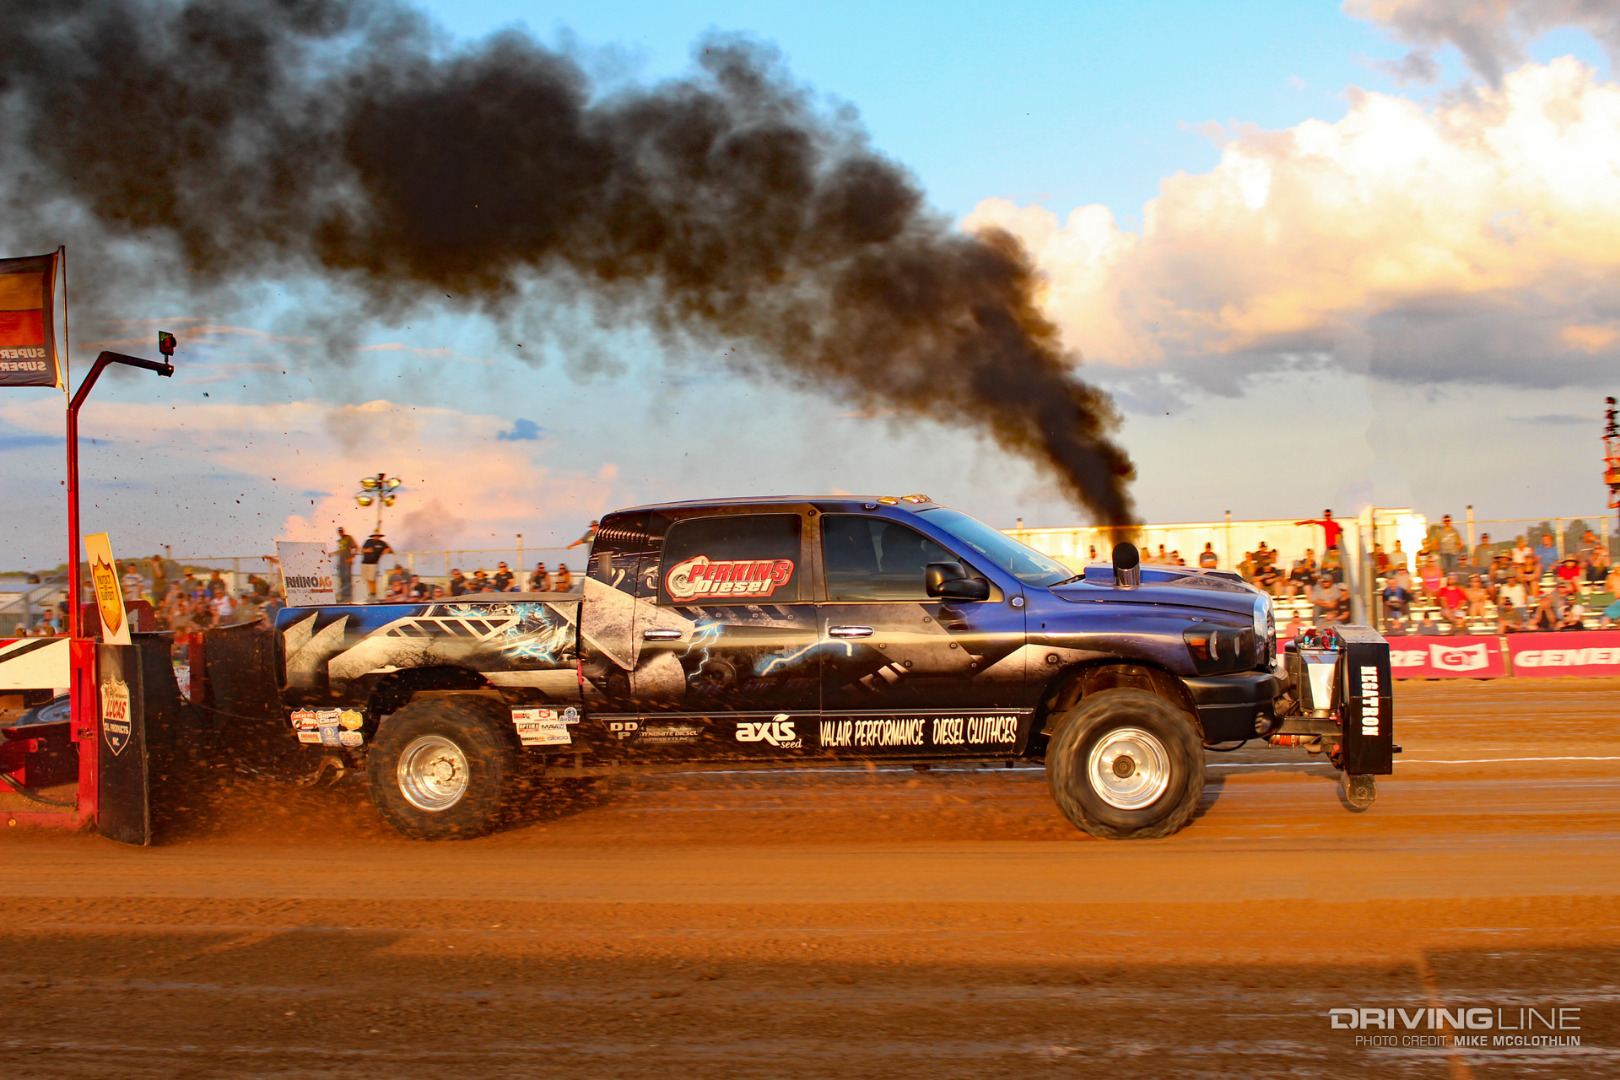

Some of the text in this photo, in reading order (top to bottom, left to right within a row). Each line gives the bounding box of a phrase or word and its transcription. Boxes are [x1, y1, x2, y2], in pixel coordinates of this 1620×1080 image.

[285, 576, 332, 588] RHINOAG
[687, 562, 789, 583] PERKINS
[693, 578, 773, 593] Diesel
[106, 700, 128, 720] LUCAS
[1360, 665, 1379, 736] MEGATRON
[735, 714, 796, 747] axis
[820, 716, 1018, 747] VALAIR PERFORMANCE DIESEL CLUTHCES
[780, 739, 803, 748] seed
